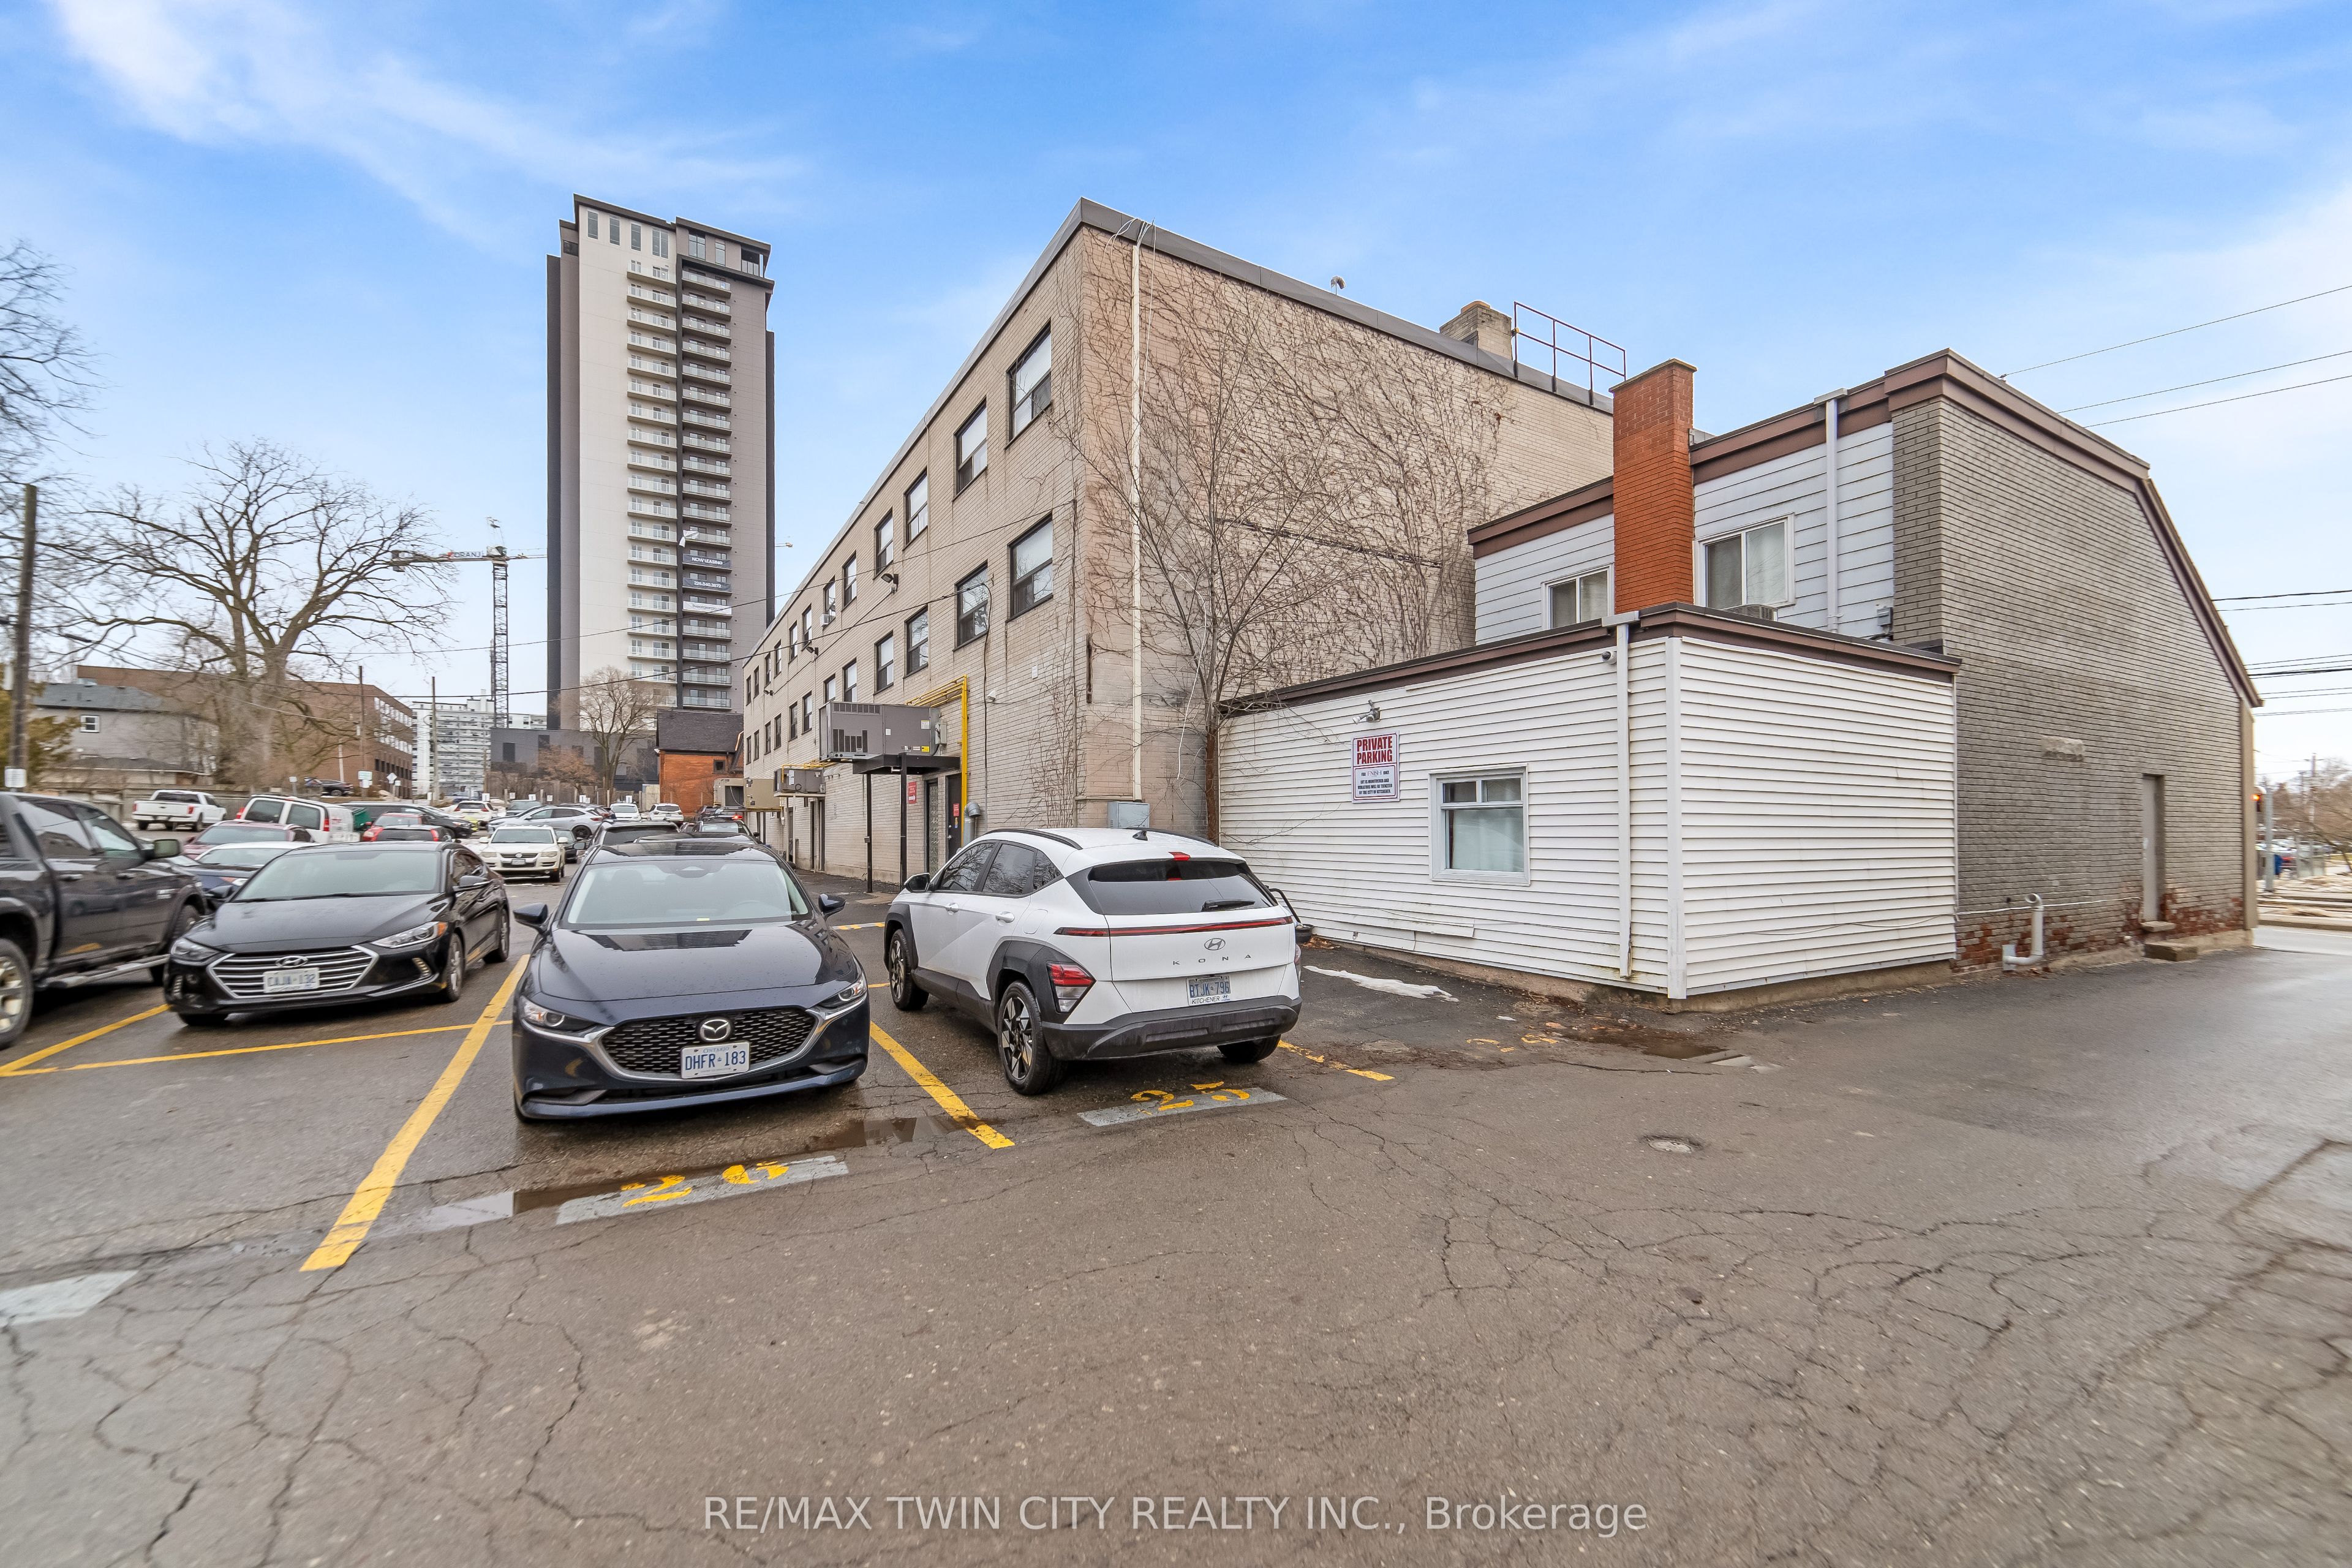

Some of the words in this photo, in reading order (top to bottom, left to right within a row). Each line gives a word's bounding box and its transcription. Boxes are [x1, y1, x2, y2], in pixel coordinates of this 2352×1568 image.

[1357, 736, 1393, 752] PRIVATE
[1357, 749, 1393, 764] PARKING
[1172, 954, 1251, 965] KONA
[1191, 996, 1220, 1005] KITCHENER
[685, 1054, 715, 1071] DHFR
[725, 1050, 746, 1066] 183
